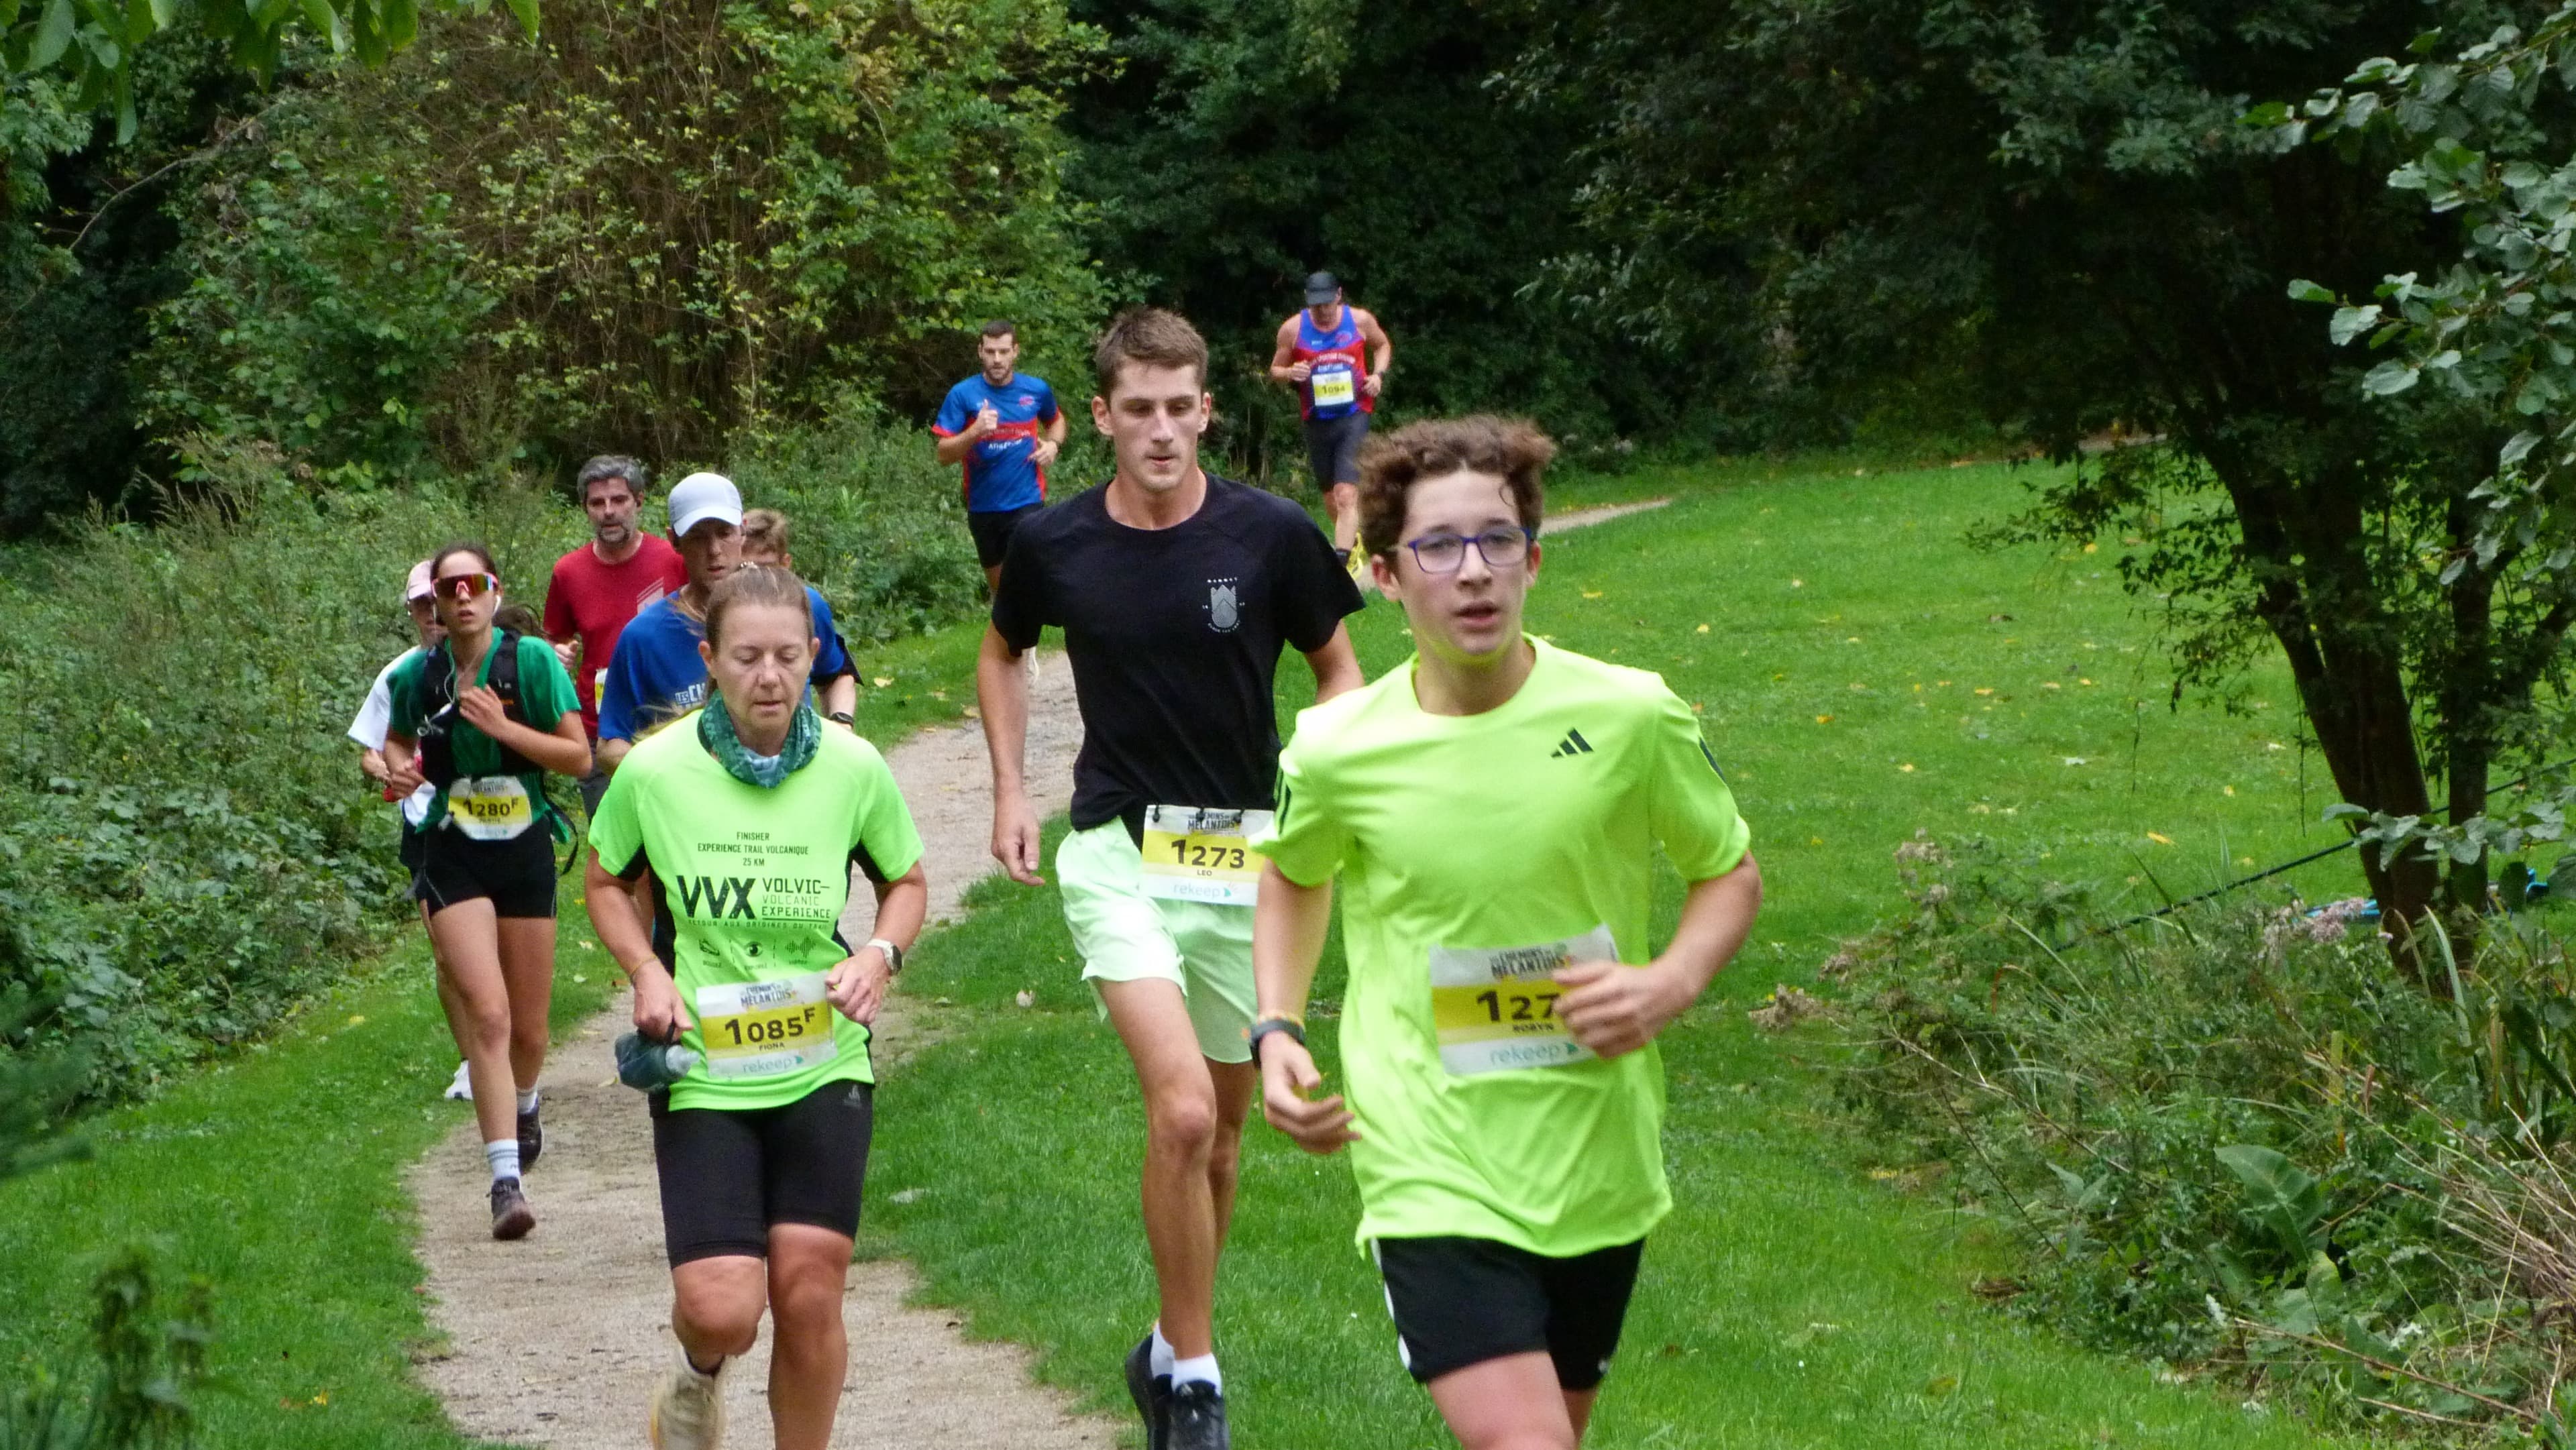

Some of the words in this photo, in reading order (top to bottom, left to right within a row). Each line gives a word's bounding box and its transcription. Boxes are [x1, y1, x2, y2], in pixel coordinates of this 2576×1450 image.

[736, 831, 770, 841] FINISHER
[697, 842, 742, 853] EXPERIENCE
[744, 844, 763, 854] TRAIL
[765, 845, 809, 856] VOLCANIQUE
[1171, 839, 1245, 869] 1273
[743, 857, 752, 867] 25
[753, 858, 765, 867] KM
[676, 875, 757, 919] VVX
[1173, 882, 1220, 899] rekeep
[762, 894, 820, 905] VOLCANIC
[761, 906, 830, 919] EXPERIENCE
[1477, 991, 1560, 1022] 127
[759, 1042, 785, 1052] FIONA
[1491, 1044, 1560, 1066] rekeep
[743, 1057, 794, 1074] rekeep
